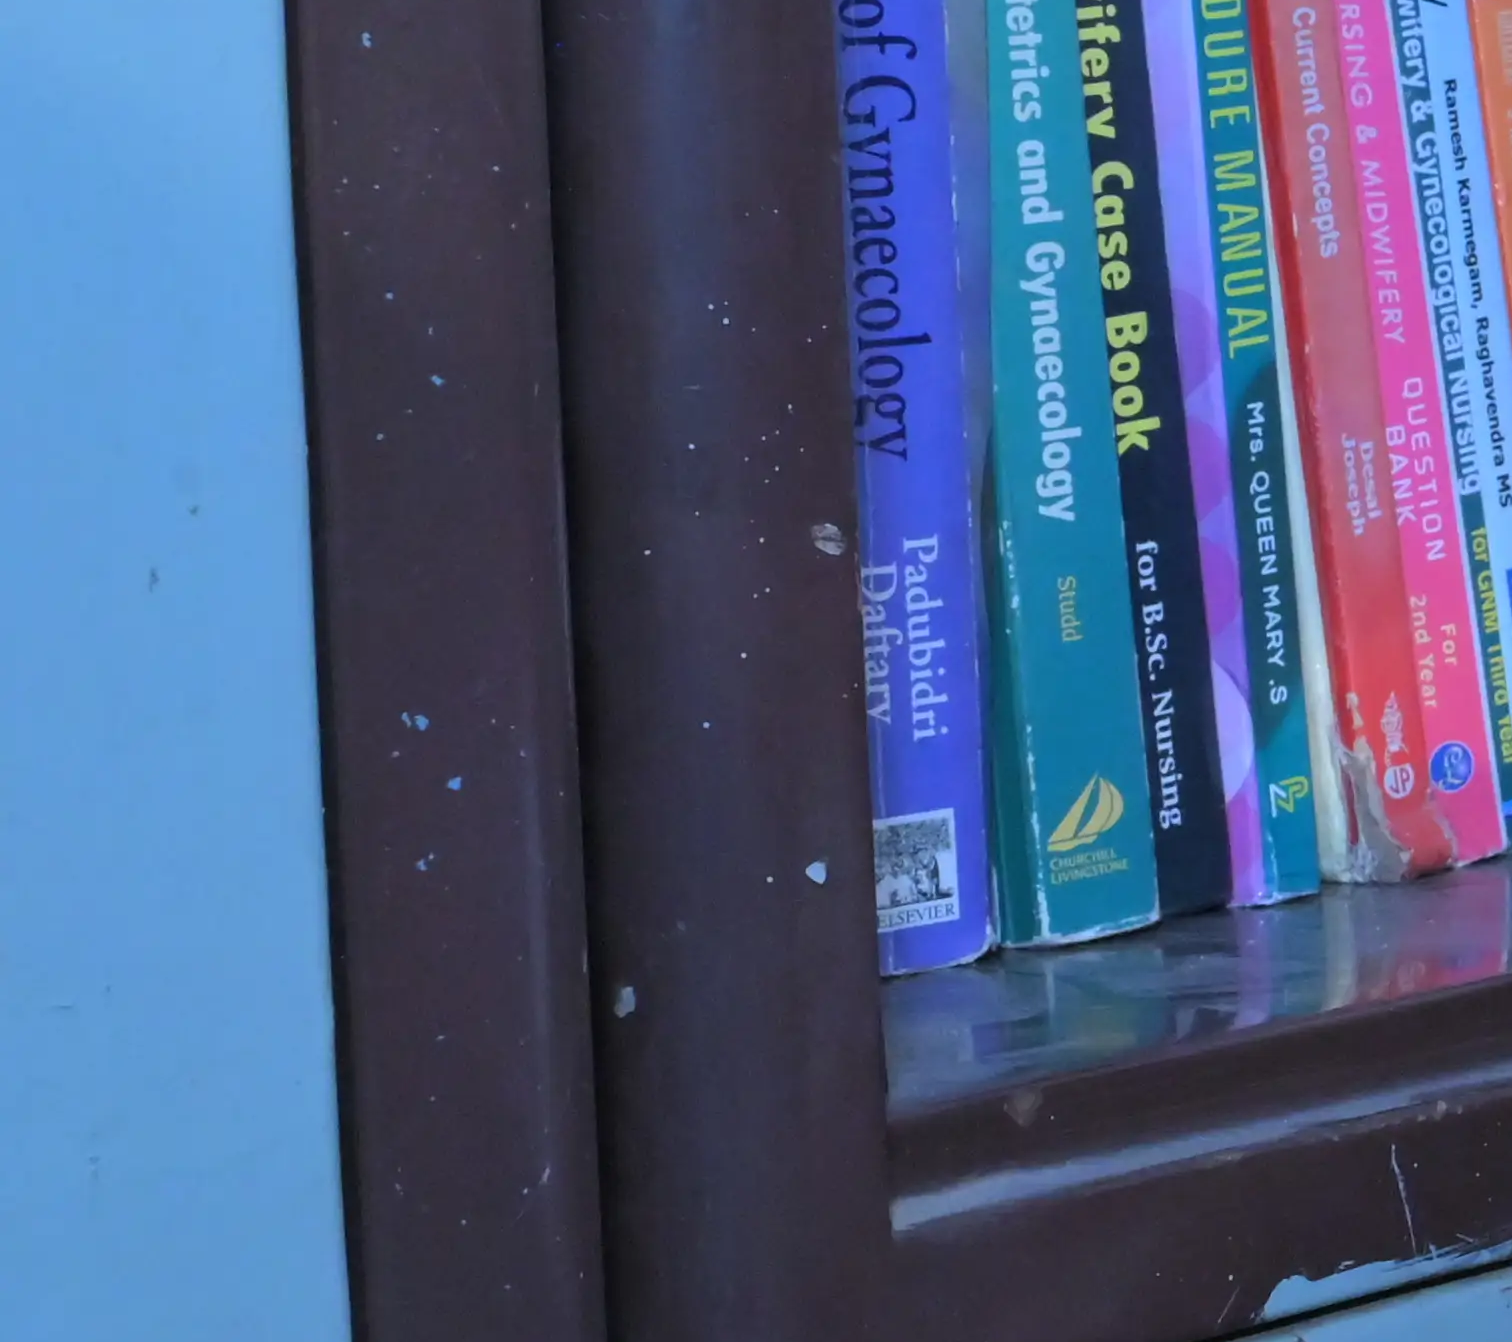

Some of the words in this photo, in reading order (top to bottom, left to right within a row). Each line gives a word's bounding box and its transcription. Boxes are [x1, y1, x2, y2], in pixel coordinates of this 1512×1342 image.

[1292, 6, 1324, 115] Current
[1016, 139, 1065, 225] and
[1356, 125, 1379, 143] &
[1091, 161, 1135, 291] Case
[1305, 123, 1341, 258] Concepts
[843, 74, 932, 461] Gynaecology
[1213, 149, 1270, 360] MANUAL
[1360, 159, 1405, 344] MIDWIFERY
[1444, 79, 1468, 171] Ramesh
[1456, 177, 1484, 309] Karmegam,
[1475, 316, 1505, 467] Raghavendra
[1497, 474, 1512, 508] MS
[1019, 240, 1084, 522] Gynaecology
[1105, 310, 1162, 456] Book
[1246, 401, 1266, 463] Mrs.
[1342, 435, 1364, 536] Joseph
[1385, 425, 1418, 526] BANK
[1402, 376, 1446, 561] QUESTION
[1136, 540, 1160, 591] for
[1249, 471, 1279, 576] QUEEN
[860, 561, 903, 724] Daftary
[901, 534, 950, 741] Padubidri
[1057, 577, 1083, 642] Studd
[1143, 603, 1168, 683] B.Sc.
[1262, 585, 1286, 669] MARY
[1409, 597, 1431, 644] 2nd
[1441, 624, 1457, 665] For
[1418, 656, 1438, 708] Year
[1151, 690, 1184, 828] Nursing
[877, 904, 956, 927] ELSEVIER
[1050, 857, 1129, 886] LIVINGSTONE
